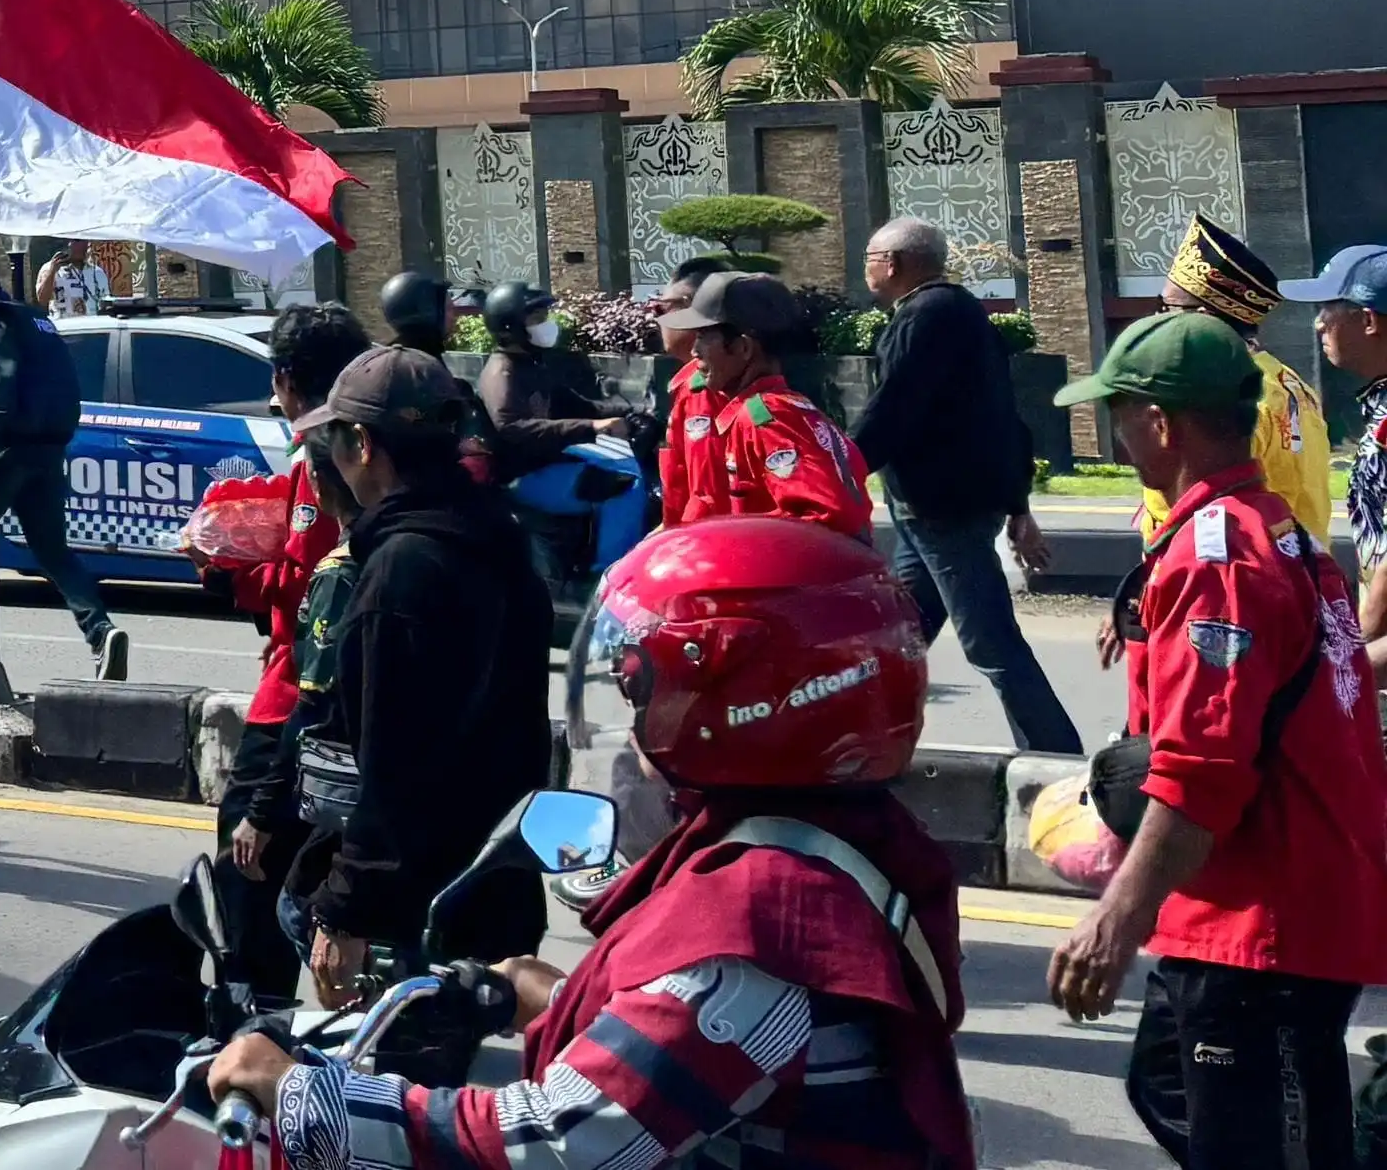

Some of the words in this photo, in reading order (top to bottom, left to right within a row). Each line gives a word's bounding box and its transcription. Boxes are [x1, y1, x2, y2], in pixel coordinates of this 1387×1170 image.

[63, 456, 193, 501] OLISI
[64, 496, 99, 511] LU
[106, 499, 194, 519] LINTAS
